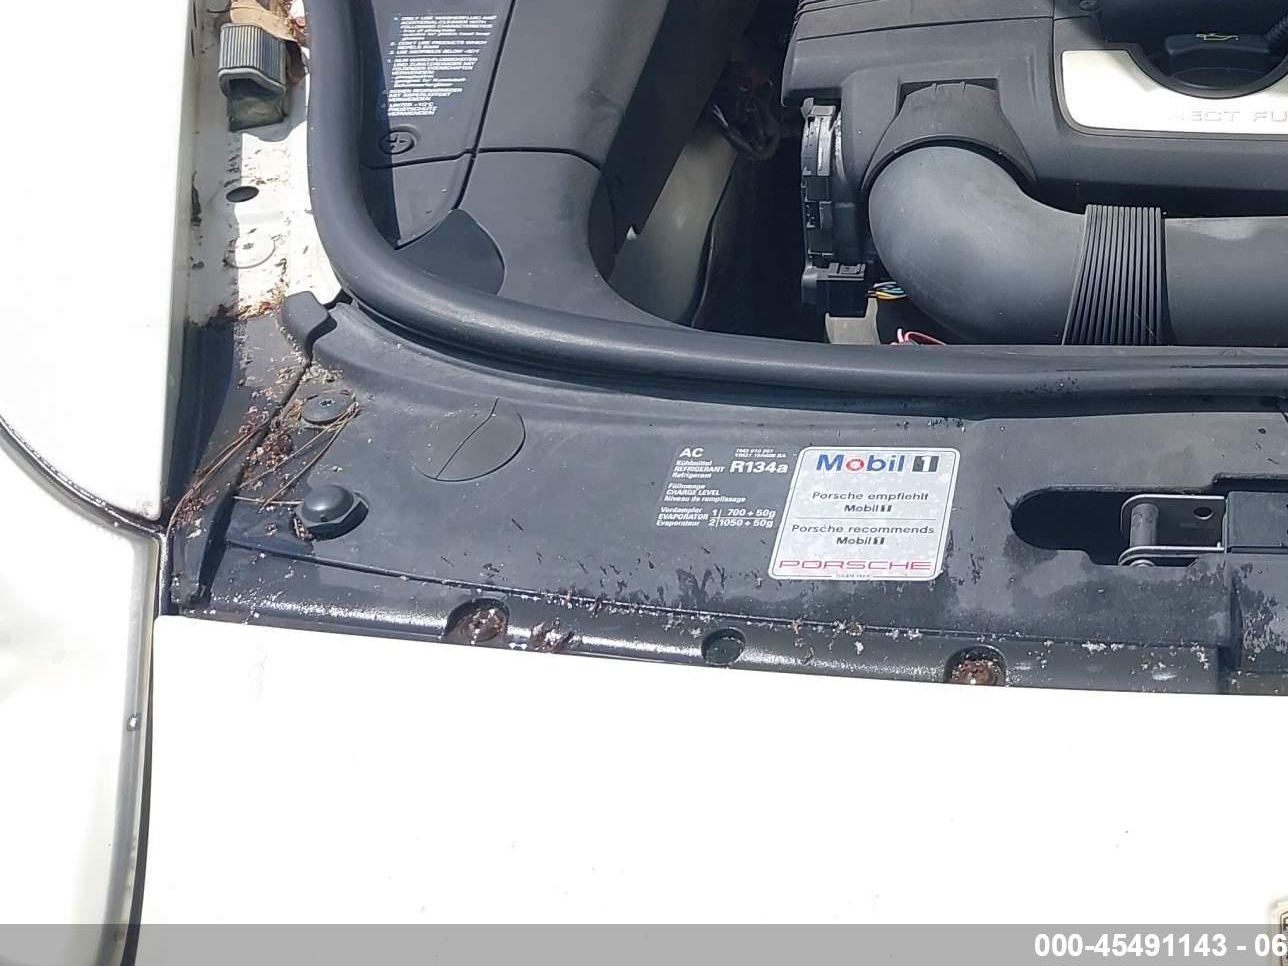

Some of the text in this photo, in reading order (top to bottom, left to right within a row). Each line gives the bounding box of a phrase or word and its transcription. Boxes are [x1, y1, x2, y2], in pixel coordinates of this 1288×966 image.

[680, 448, 704, 458] AC
[730, 460, 788, 474] R134a
[816, 454, 906, 472] Mobil
[812, 492, 928, 502] Porsche empfiehlt
[844, 504, 878, 512] Mobil
[756, 509, 776, 518] 50g
[753, 520, 774, 528] 50g
[792, 524, 934, 534] Porsche recommends
[779, 560, 932, 570] PORSCHE
